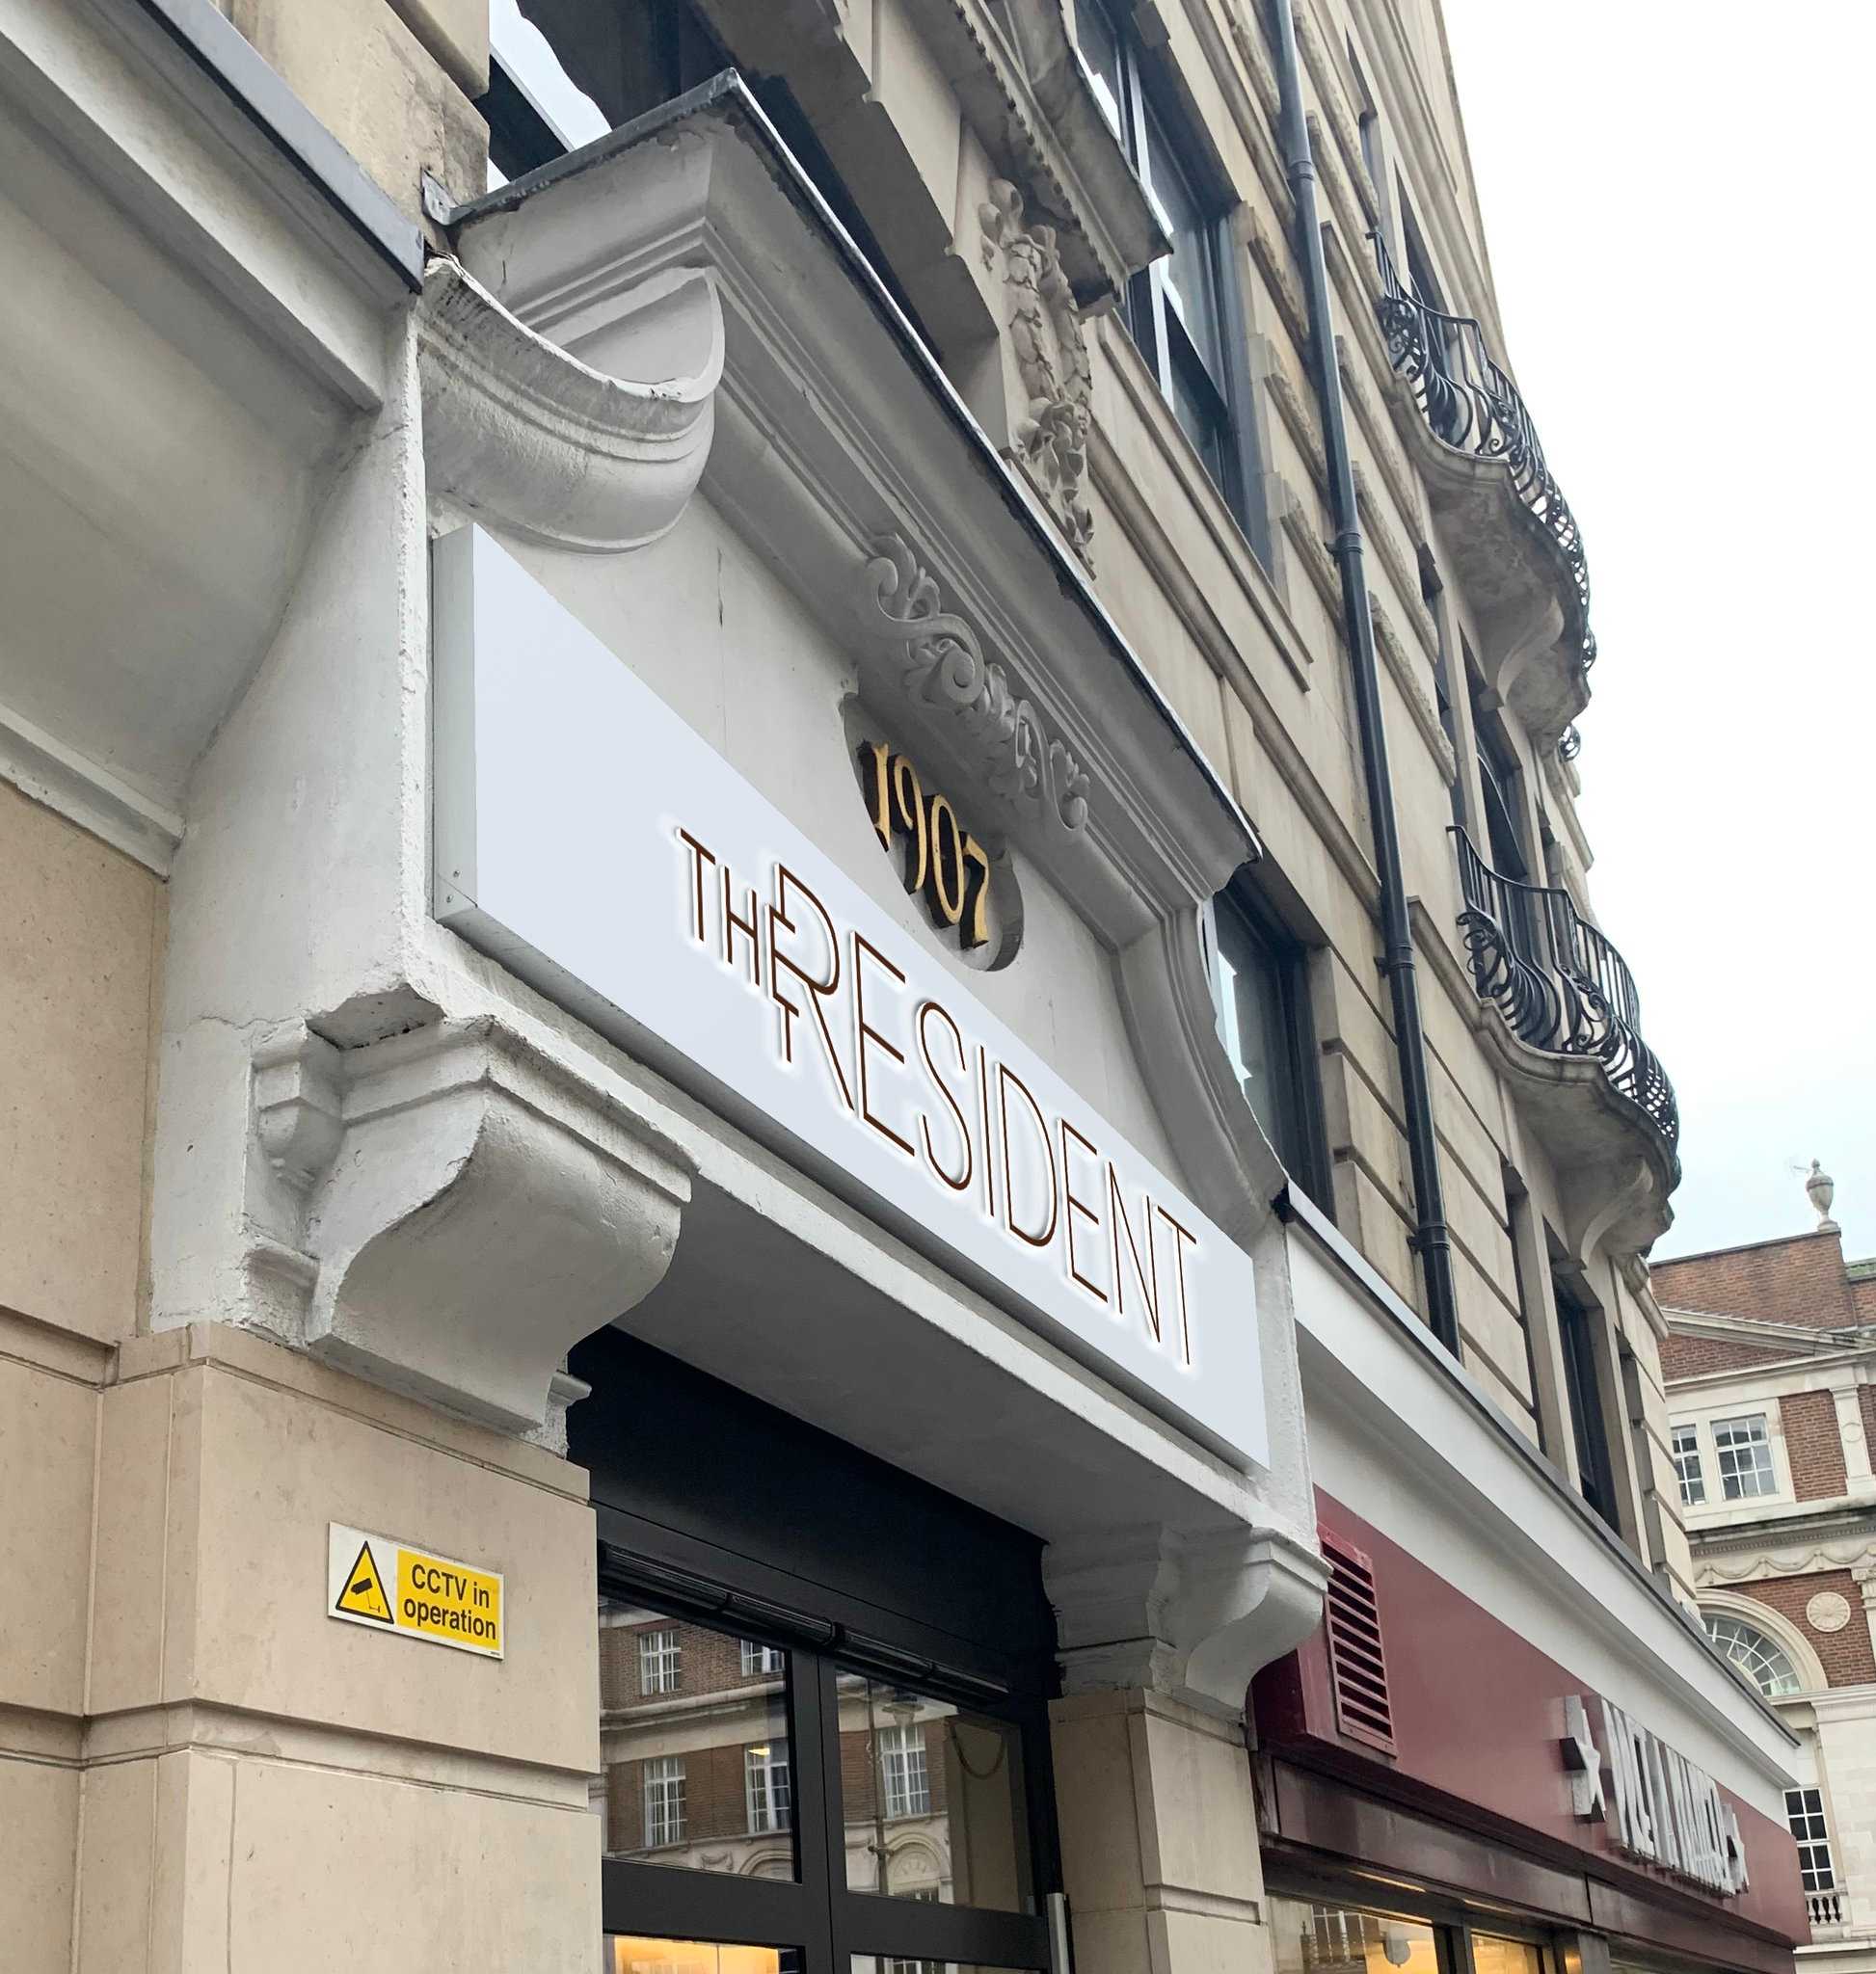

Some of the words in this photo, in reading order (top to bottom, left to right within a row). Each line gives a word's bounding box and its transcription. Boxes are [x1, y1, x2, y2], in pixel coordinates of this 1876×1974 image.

[865, 740, 990, 948] 1907
[675, 826, 800, 1019] THE
[776, 862, 1197, 1365] RESIDENT
[403, 1598, 496, 1641] operation
[411, 1563, 468, 1601] CCTV
[472, 1581, 491, 1609] in
